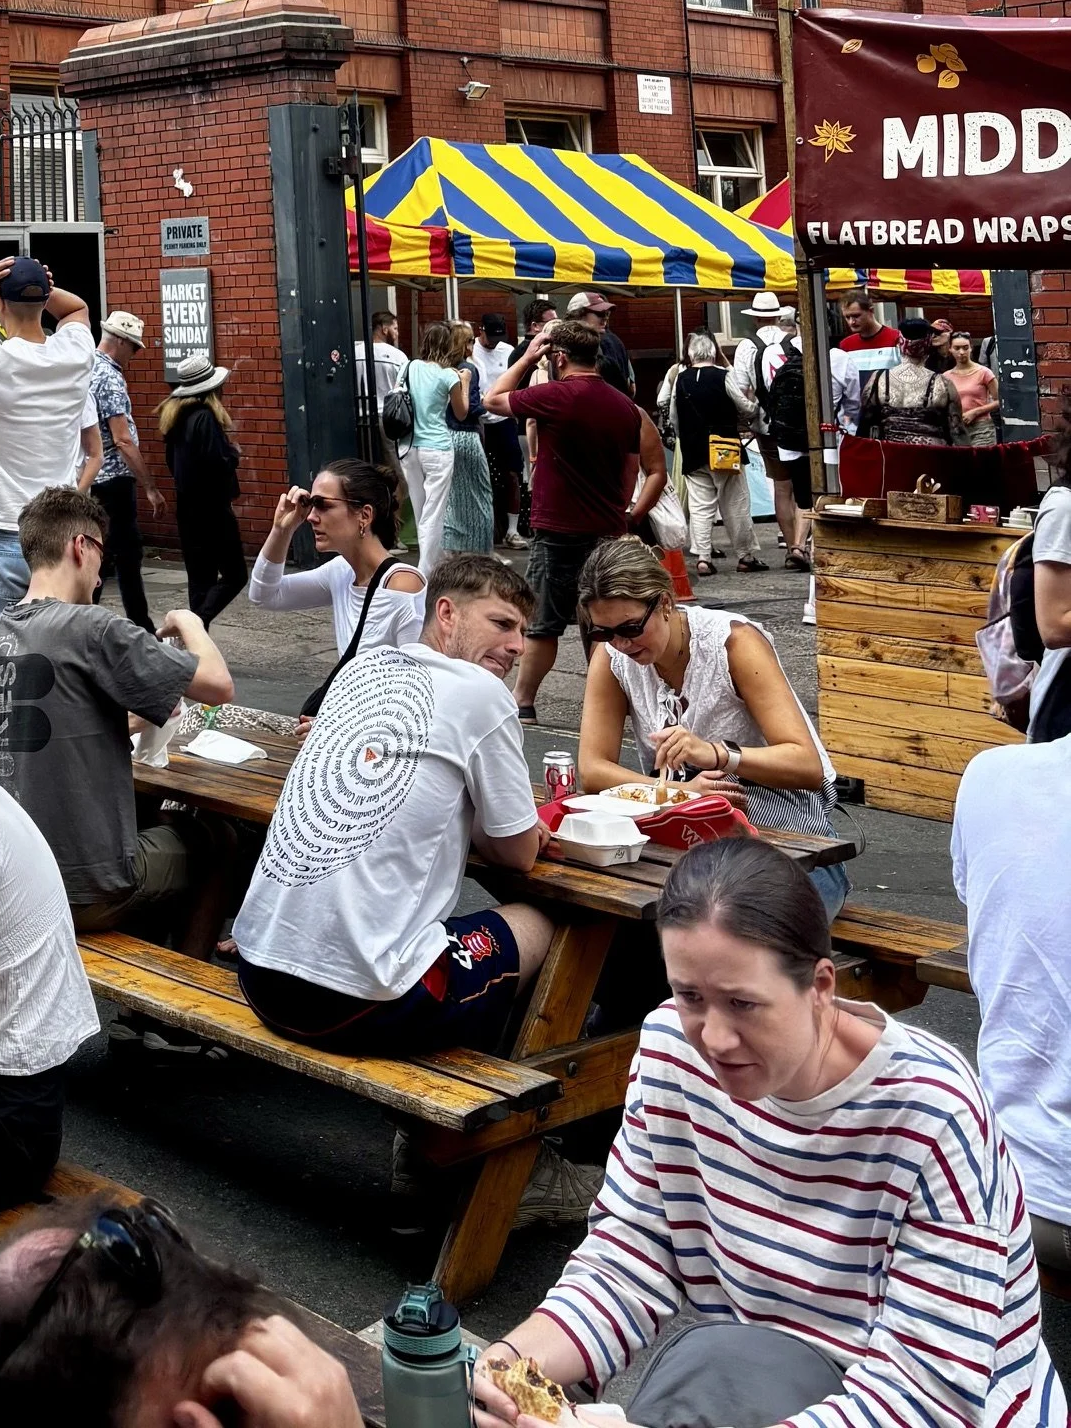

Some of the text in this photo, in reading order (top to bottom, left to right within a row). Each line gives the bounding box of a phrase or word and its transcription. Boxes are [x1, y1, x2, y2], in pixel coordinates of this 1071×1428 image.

[166, 225, 203, 240] PRIVATE
[806, 215, 1071, 246] FLATBREAD WRAPS
[162, 283, 206, 301] MARKET
[163, 302, 207, 325] EVERY
[164, 326, 208, 344] SUNDAY
[165, 348, 181, 358] 10AM
[364, 654, 379, 662] All
[379, 658, 400, 666] Gear
[349, 688, 373, 702] Gear
[375, 682, 387, 690] All
[357, 704, 376, 715] Gear
[376, 698, 386, 707] All
[381, 707, 395, 717] Gear
[394, 711, 404, 721] All
[349, 710, 381, 730] Conditions
[363, 723, 376, 731] Gear
[318, 715, 357, 750] Conditions
[340, 728, 350, 738] All
[297, 757, 308, 811] Conditions
[337, 691, 382, 719] Conditions
[402, 689, 412, 699] All
[327, 738, 340, 755] Gear
[311, 751, 321, 763] All
[402, 759, 411, 770] All
[404, 749, 420, 787] onditions
[307, 765, 317, 789] Gear
[380, 769, 407, 799] Conditions
[322, 789, 333, 802] All
[353, 795, 367, 806] All
[366, 793, 380, 804] Gear
[388, 787, 405, 806] Gear
[310, 789, 339, 829] Conditions
[328, 798, 342, 814] Gear
[377, 803, 388, 816] All
[299, 810, 311, 823] All
[340, 809, 377, 821] Conditions
[288, 805, 322, 853] Conditions
[306, 821, 323, 839] Gear
[337, 823, 358, 833] All
[358, 819, 379, 830] Gear
[280, 826, 291, 841] All
[322, 833, 371, 845] Conditions
[287, 842, 304, 859] Gear
[322, 847, 346, 855] All
[271, 858, 288, 877] Gear
